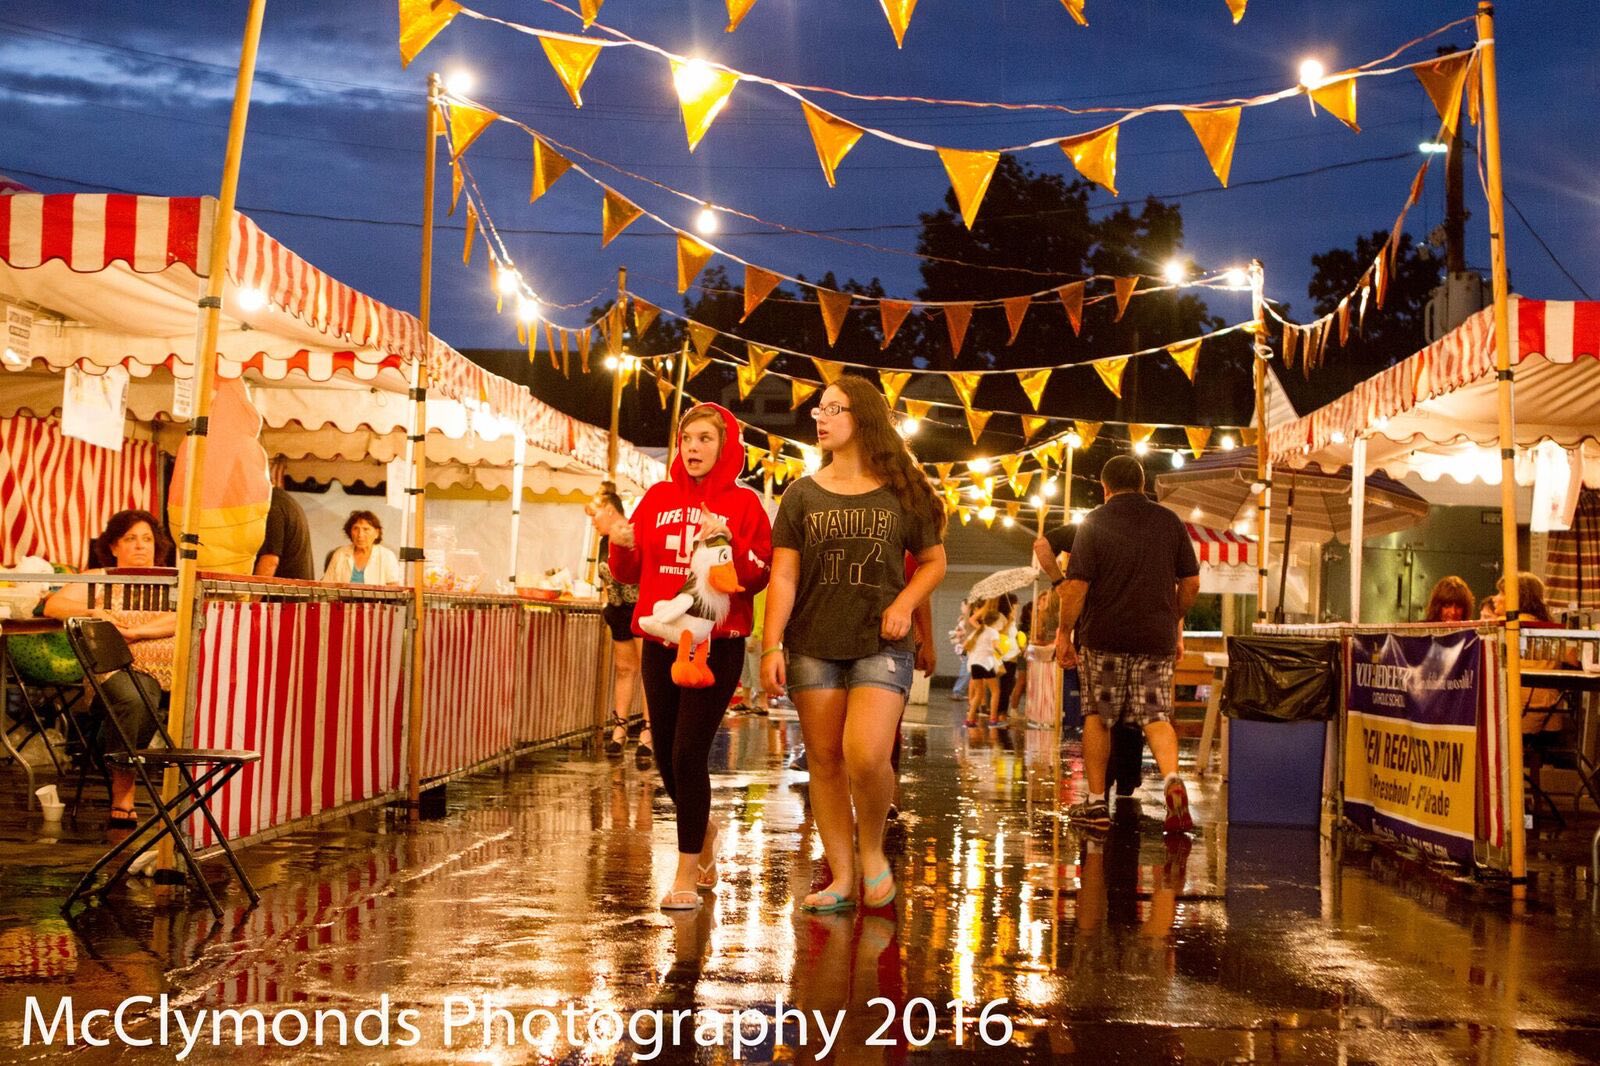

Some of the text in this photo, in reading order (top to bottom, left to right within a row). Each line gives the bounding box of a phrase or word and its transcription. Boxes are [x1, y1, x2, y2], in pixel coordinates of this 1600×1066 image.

[804, 508, 898, 546] NAILED
[660, 565, 685, 575] MYRTLE
[817, 549, 844, 584] IT
[1373, 774, 1412, 806] Preschool
